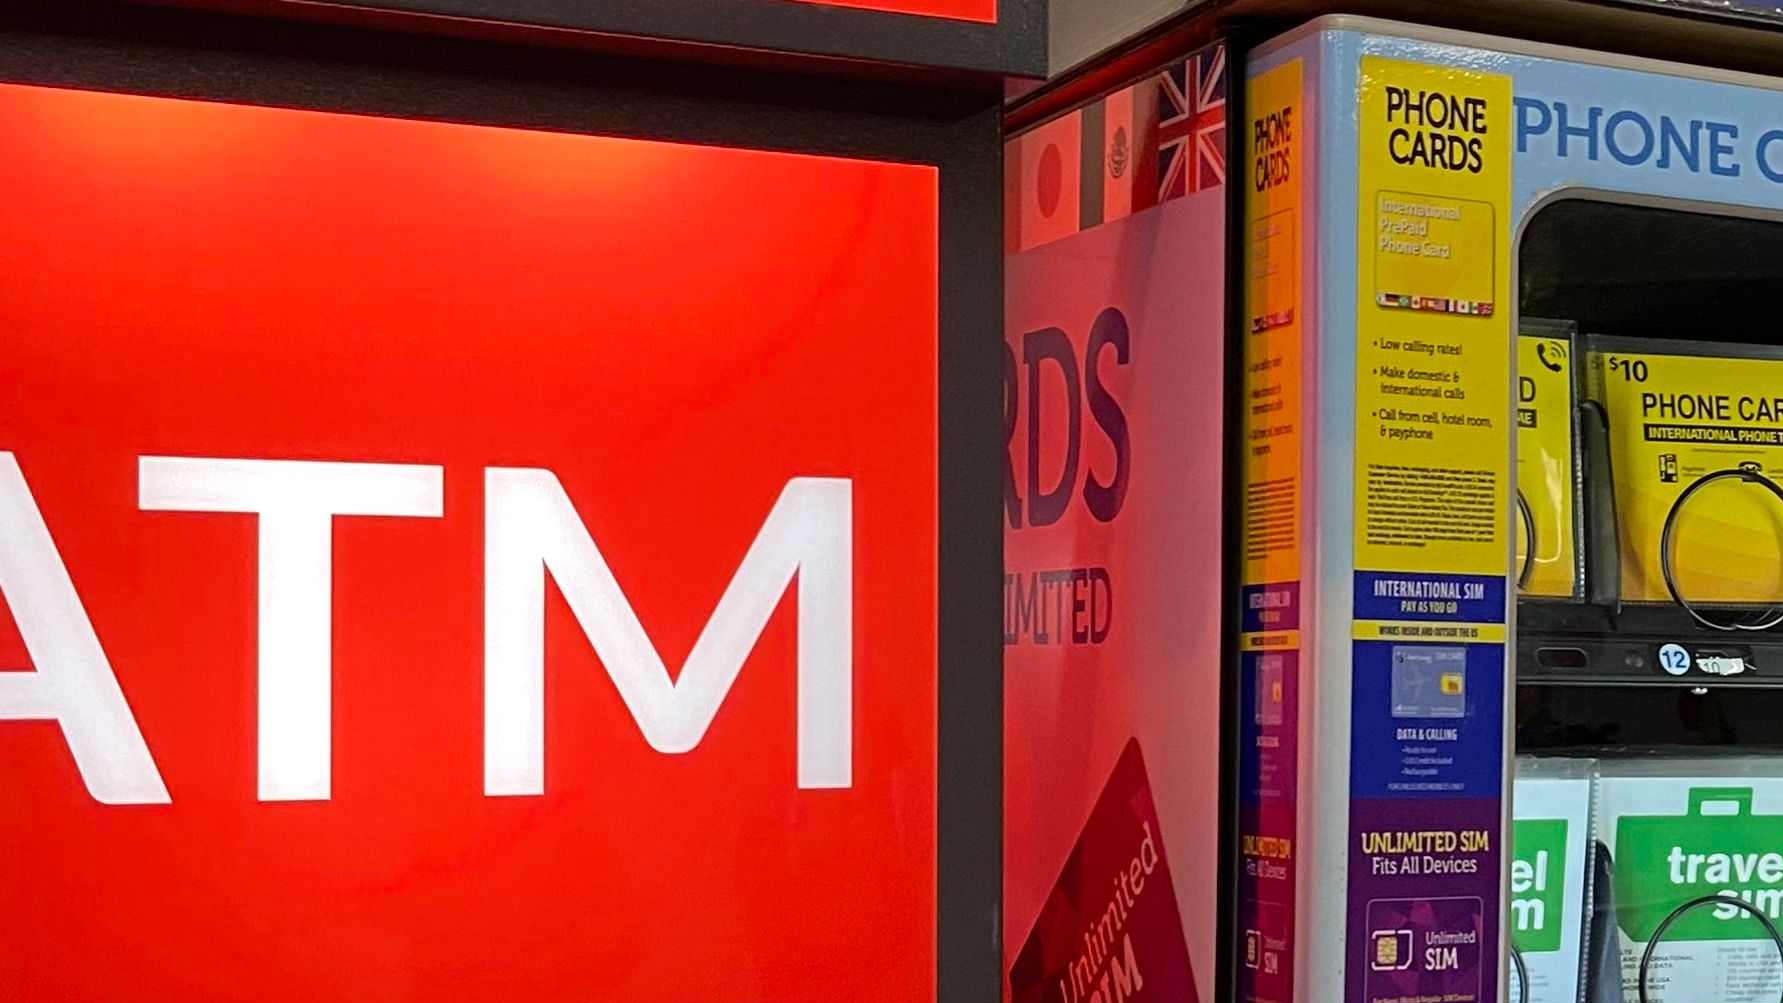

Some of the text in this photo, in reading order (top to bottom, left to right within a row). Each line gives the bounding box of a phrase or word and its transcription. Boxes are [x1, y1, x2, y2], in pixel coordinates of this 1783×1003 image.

[1385, 86, 1487, 134] PHONE
[1254, 107, 1292, 155] PHONE
[1513, 96, 1740, 177] PHONE
[1389, 128, 1483, 174] CARDS
[1255, 147, 1289, 192] CARDS
[1380, 199, 1460, 220] International
[1380, 236, 1450, 259] Phone Card
[1380, 338, 1462, 356] Low calling rates!
[1380, 366, 1459, 382] Make domestic &
[1609, 358, 1648, 383] $10
[1381, 383, 1465, 400] international calls
[1642, 392, 1731, 422] PHONE
[1649, 426, 1737, 442] INTERNATIONAL
[1739, 428, 1778, 442] PHONE
[1374, 580, 1484, 599] INTERNATIONAL SIM
[0, 450, 854, 805] ATM
[1661, 650, 1687, 669] 12
[1397, 729, 1457, 740] DATA & CALLING
[1361, 831, 1489, 853] UNLIMITED SIM
[1372, 856, 1477, 874] Fits All Devices
[1426, 931, 1476, 945] Unlimited
[1426, 948, 1458, 970] SIM
